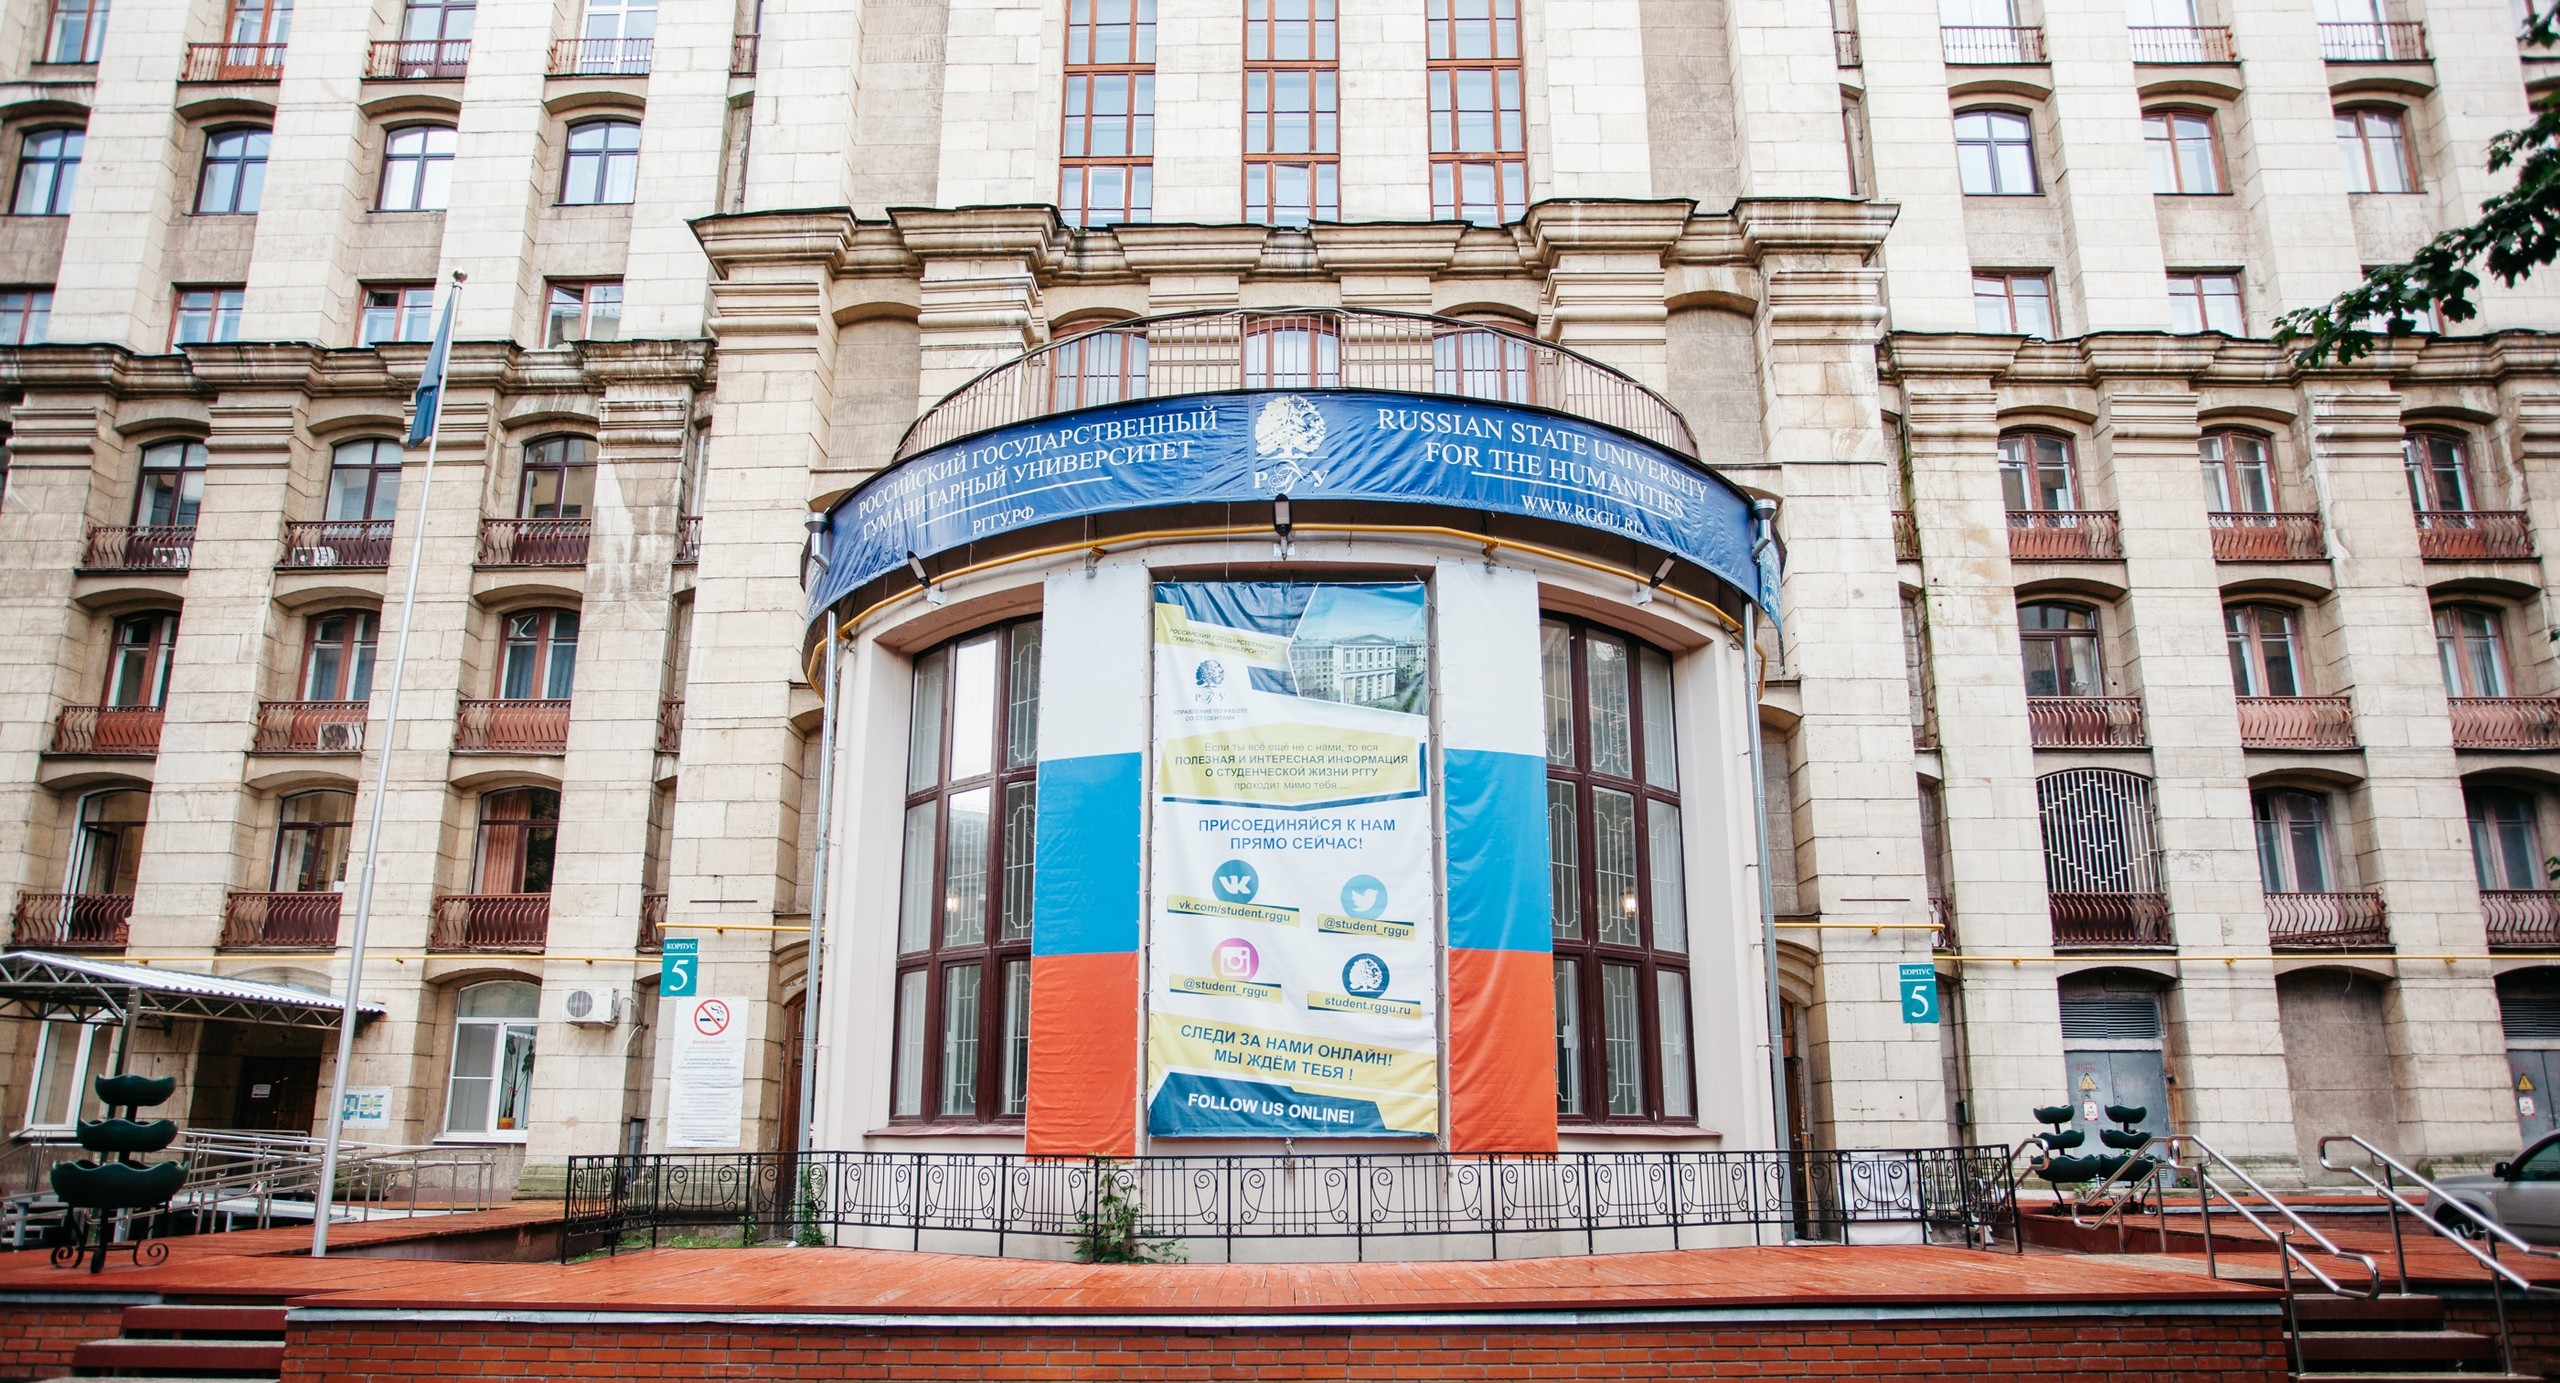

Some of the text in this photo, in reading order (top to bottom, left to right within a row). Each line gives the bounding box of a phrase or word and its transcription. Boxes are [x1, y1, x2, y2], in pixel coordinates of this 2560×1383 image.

[858, 405, 1218, 520] РОССИЙСКИЙ ГОСУДАРСТВЕННЫЙ
[1377, 409, 1707, 502] RUSSIAN STATE UNIVERSITY
[863, 440, 1194, 541] ГУМАНИТАРНЫЙ УНИВЕРСИТЕТ
[1425, 442, 1685, 519] FOR THE HUMANITIES
[972, 505, 1035, 535] РГГУ.РФ
[1521, 495, 1645, 536] WWW.RGGU.RU
[1212, 634, 1275, 650] ГОСУДАРСТВЕННЫЙ
[1224, 643, 1268, 656] УНИВЕРСИТЕТ
[1204, 742, 1229, 751] Если
[1248, 742, 1265, 751] всё
[1268, 742, 1289, 752] ещё
[1315, 744, 1344, 752] нами,
[1175, 754, 1408, 765] ПОЛЕЗНАЯ И ИНТЕРЕСНАЯ ИНФОРМАЦИЯ
[1205, 766, 1378, 778] О СТУДЕНЧЕСКОЙ ЖИЗНИ РГГУ
[1234, 781, 1280, 791] проходит
[1314, 780, 1337, 789] тебя
[1199, 816, 1395, 832] ПРИСОЕДИНЯЙСЯ К НАМ
[1230, 834, 1362, 850] ПРЯМО СЕЙЧАС!
[1179, 901, 1290, 922] vk.com/student.rggu
[1324, 918, 1409, 936] @student_rggu
[669, 959, 688, 991] 5
[1184, 978, 1268, 998] @student_rggu
[1324, 996, 1411, 1016] student.rggu.ru
[1912, 986, 1929, 1017] 5
[1181, 1024, 1392, 1066] СЛЕДИ ЗА НАМИ ОНЛАЙН!
[1214, 1049, 1242, 1064] МЫ
[1247, 1054, 1296, 1072] ЖДЁМ
[1302, 1062, 1343, 1079] ТЕБЯ
[1188, 1093, 1354, 1124] FOLLOW US ONLINE!
